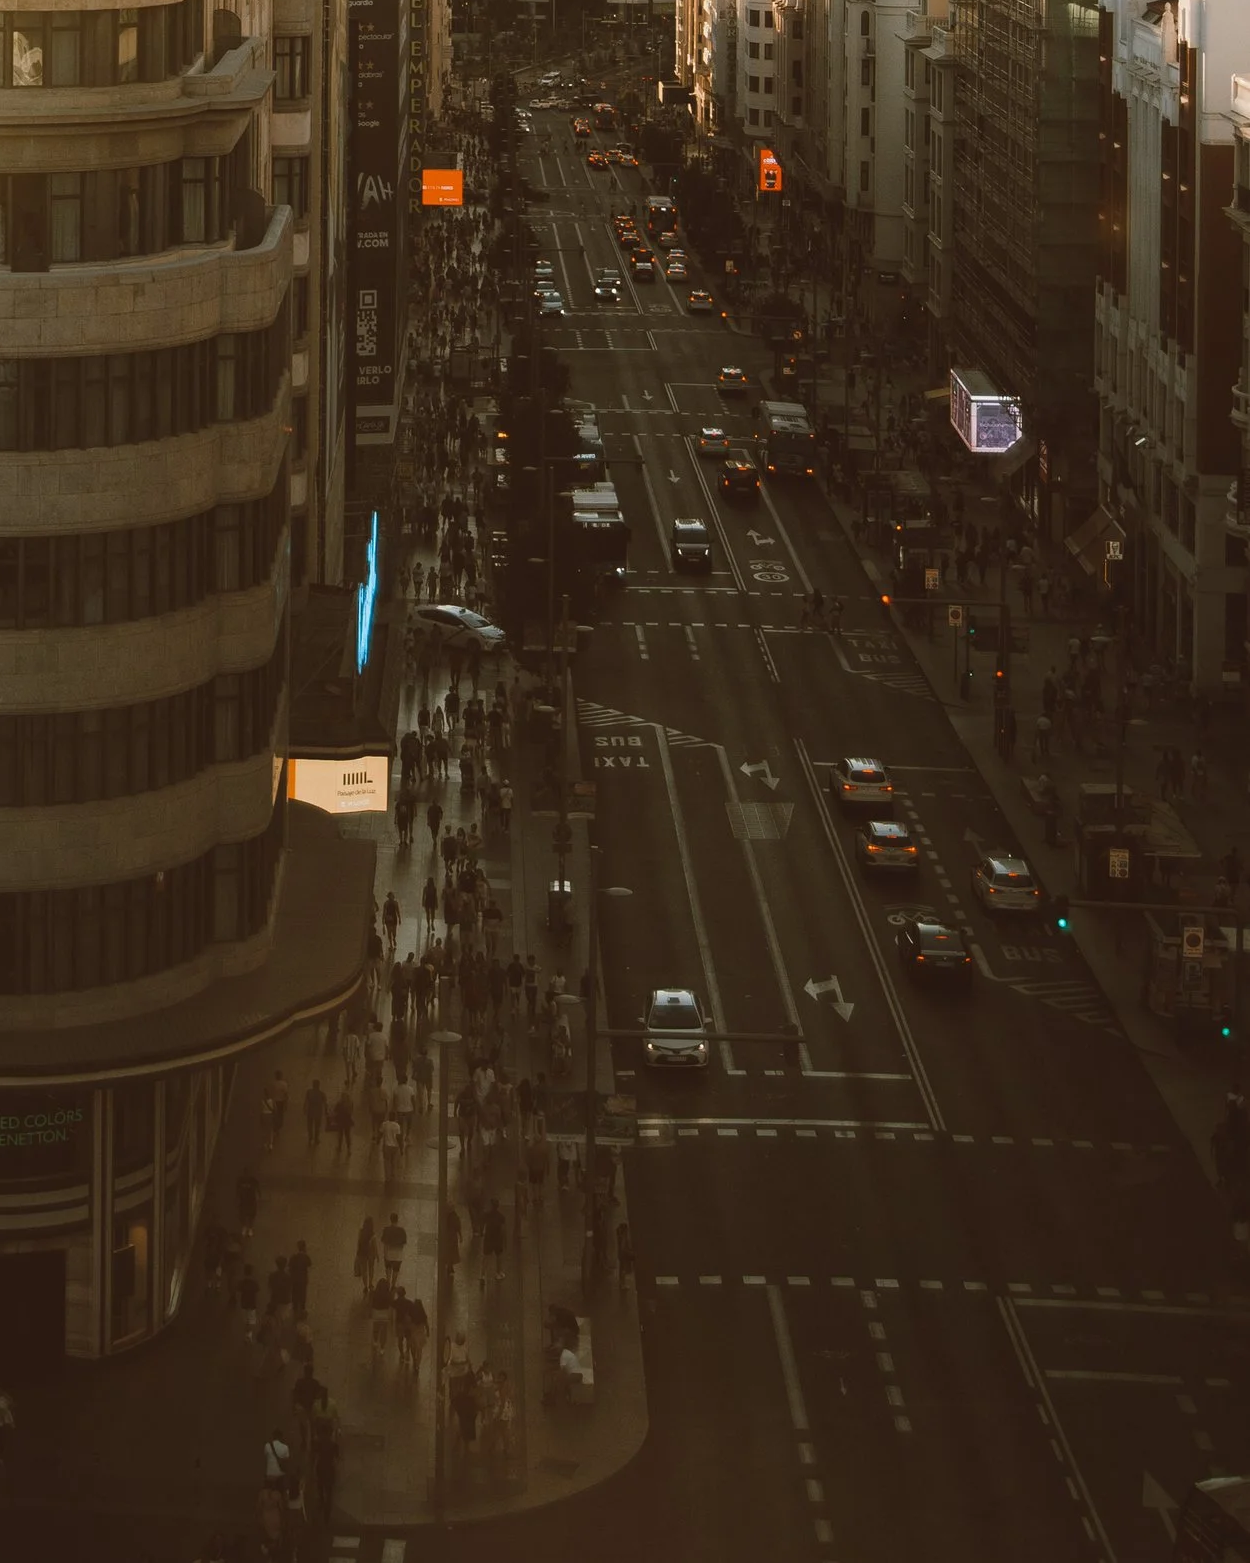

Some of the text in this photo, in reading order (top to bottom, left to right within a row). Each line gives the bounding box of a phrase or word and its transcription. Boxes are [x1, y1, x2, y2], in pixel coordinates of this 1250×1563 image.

[408, 40, 424, 214] EMPERADOR
[357, 172, 394, 210] AH
[357, 231, 378, 239] RADA
[358, 365, 392, 375] VERLO
[846, 638, 899, 651] TAXI
[857, 652, 902, 664] BUS
[593, 735, 643, 747] BUS
[593, 755, 650, 768] TAXI
[1000, 944, 1064, 964] BUS
[23, 1108, 84, 1130] COLORS
